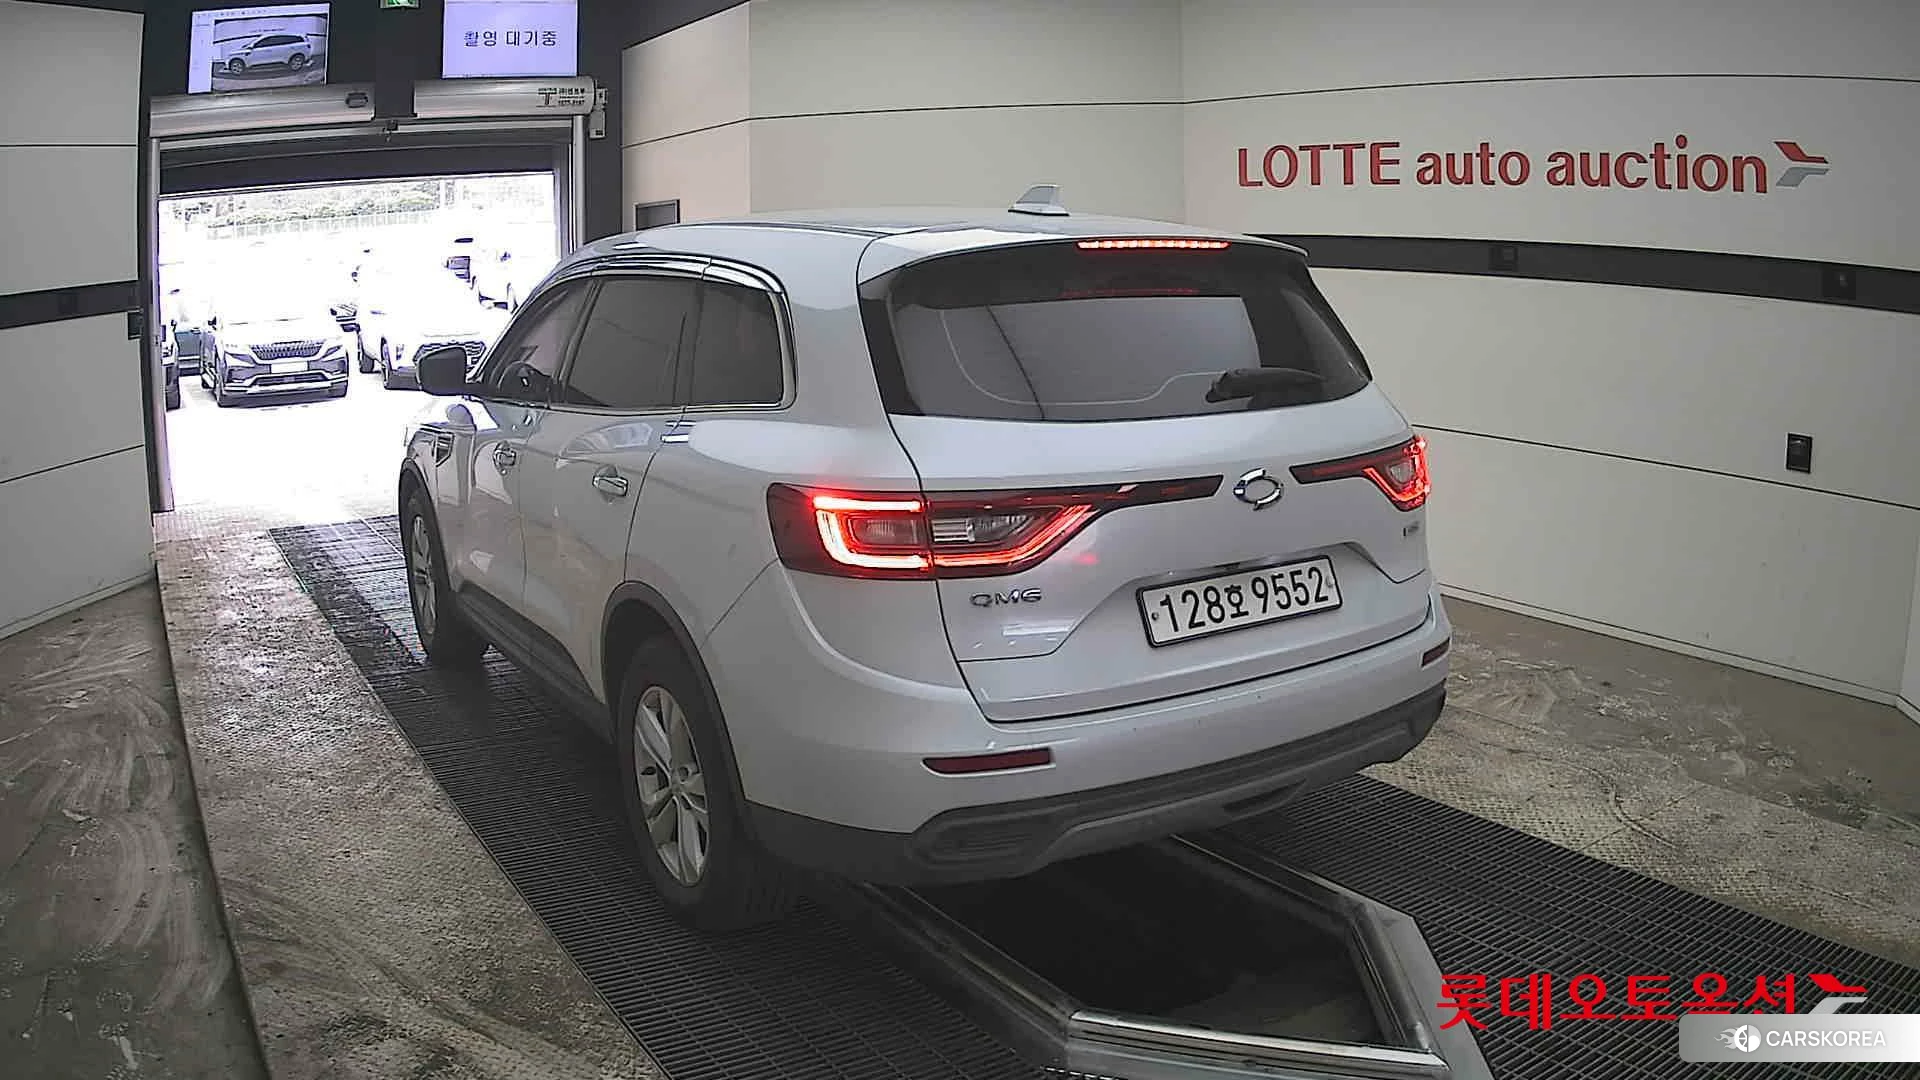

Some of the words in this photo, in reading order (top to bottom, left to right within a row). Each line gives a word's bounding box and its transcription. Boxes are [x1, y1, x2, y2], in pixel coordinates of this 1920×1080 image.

[505, 29, 558, 47] 대기중
[1238, 141, 1401, 188] LOTTE
[1416, 142, 1530, 186] auto
[1546, 135, 1767, 194] auction
[970, 588, 1041, 608] QM6
